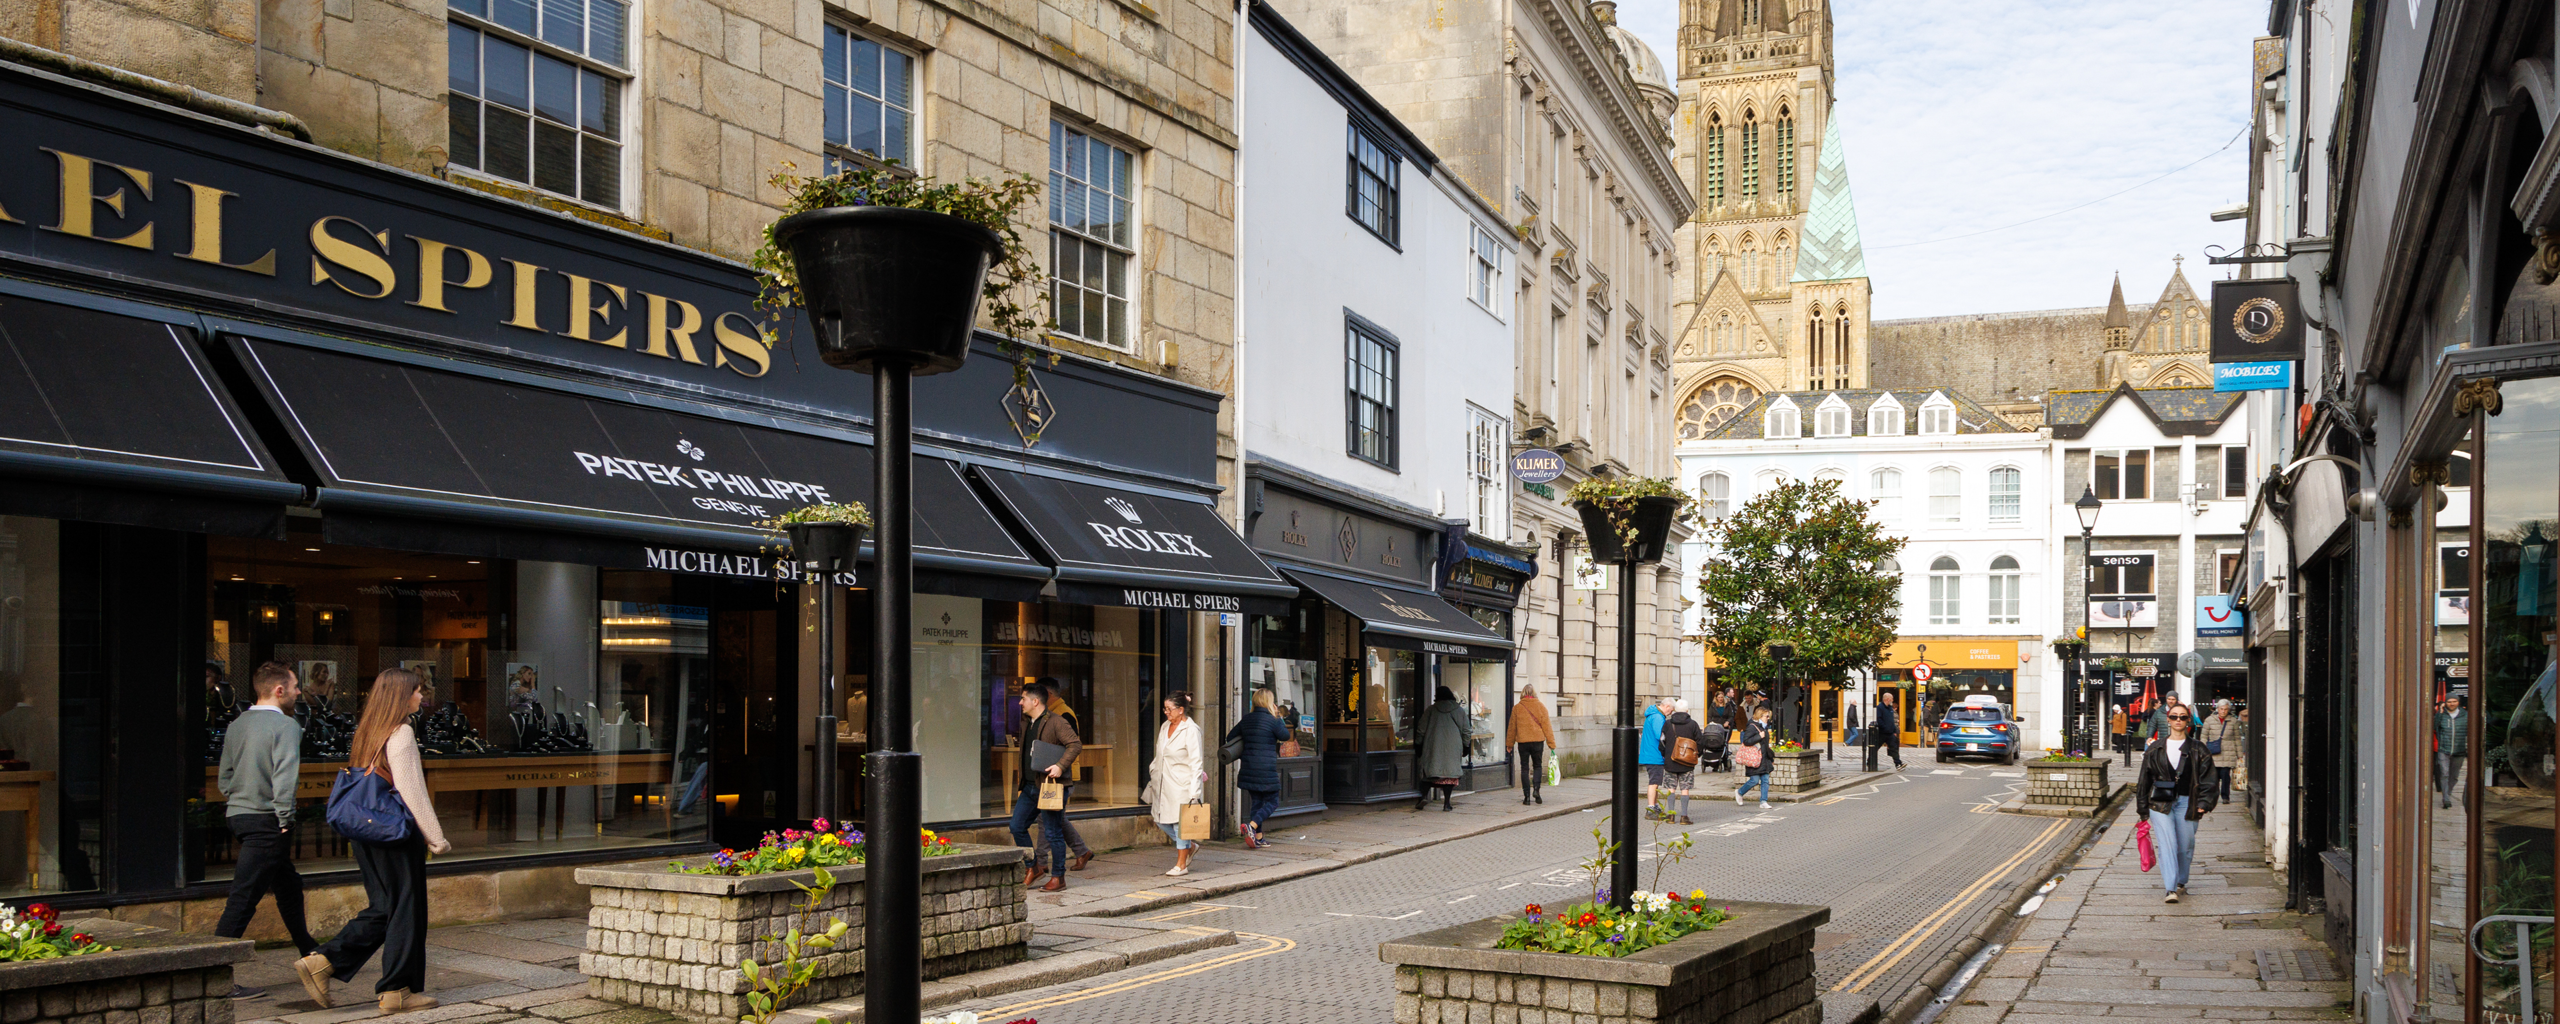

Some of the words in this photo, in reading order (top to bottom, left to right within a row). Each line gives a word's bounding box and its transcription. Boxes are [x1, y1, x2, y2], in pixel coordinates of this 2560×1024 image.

[0, 145, 277, 278] EL
[310, 215, 772, 379] SPIERS
[2250, 311, 2268, 329] D
[2220, 365, 2281, 378] MOBILES
[1516, 457, 1559, 470] KLIMEK
[573, 451, 697, 489] PATEK
[692, 467, 838, 506] PHILIPPE
[1519, 470, 1557, 478] Jewellers
[692, 497, 771, 518] GENEVE
[1087, 522, 1213, 559] ROLEX
[1283, 531, 1308, 547] ROLEX
[644, 546, 767, 578] MICHAEL
[1381, 554, 1402, 568] ROLEX
[2103, 557, 2140, 565] senso
[1473, 573, 1494, 589] KLIMEK
[1124, 590, 1190, 609] MICHAEL
[1195, 594, 1240, 612] SPIERS
[922, 627, 941, 637] PATEK
[942, 628, 968, 639] PHILIPPE
[1423, 641, 1448, 653] MICHAEL
[1449, 645, 1468, 656] SPIERS
